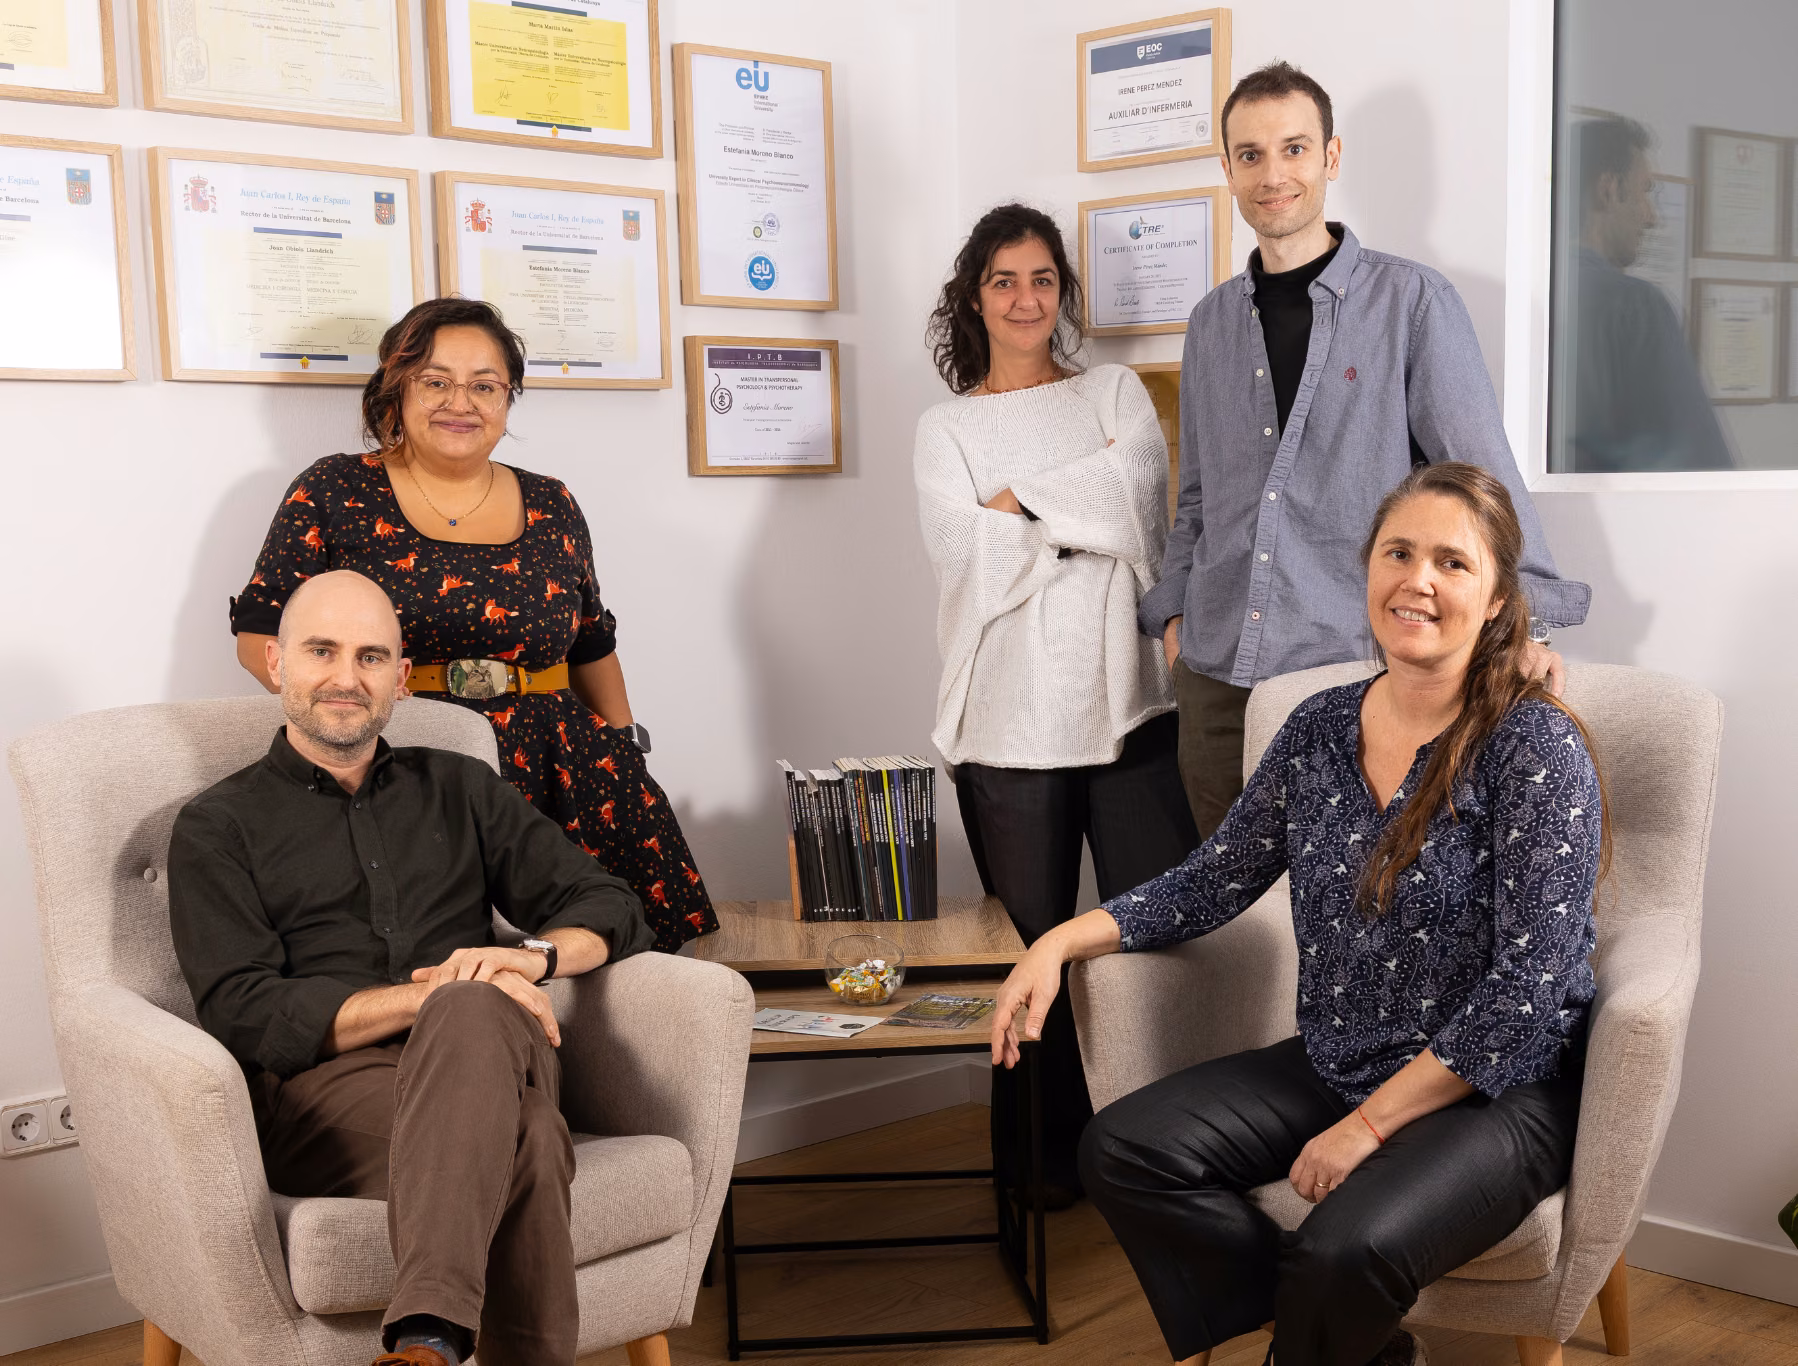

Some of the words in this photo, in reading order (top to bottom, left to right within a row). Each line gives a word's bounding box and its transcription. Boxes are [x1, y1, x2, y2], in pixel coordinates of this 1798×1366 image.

[1146, 43, 1162, 53] EOC
[1119, 87, 1135, 95] IRENE
[1109, 107, 1140, 120] AUXILIAR
[774, 152, 794, 160] Blanco
[5, 196, 40, 204] Barcelona
[240, 188, 259, 198] Juan
[261, 190, 286, 200] Carlos
[296, 193, 310, 203] Rey
[312, 195, 321, 203] de
[279, 214, 312, 222] Universitat
[323, 217, 352, 225] Barcelona
[512, 211, 527, 219] Juan
[529, 212, 550, 220] Carlos
[558, 214, 570, 223] Rey
